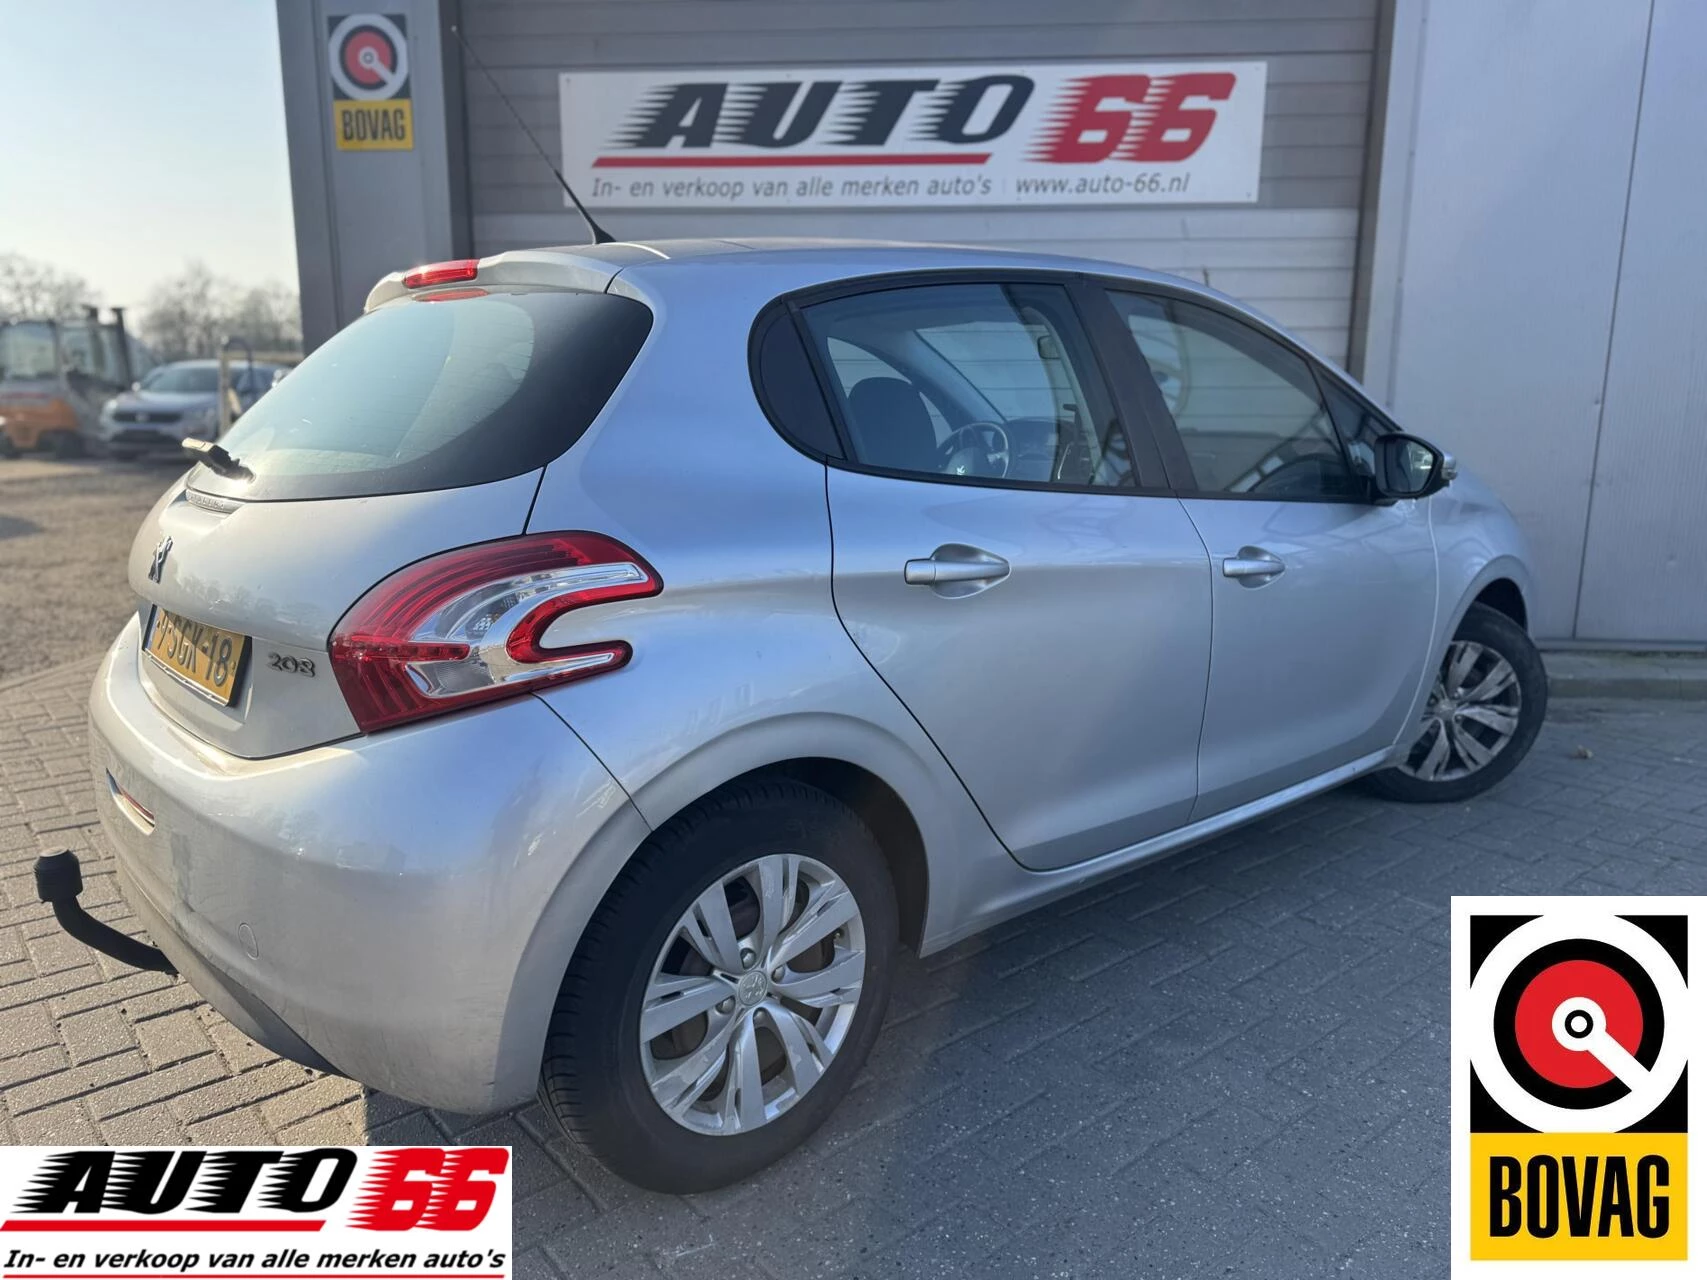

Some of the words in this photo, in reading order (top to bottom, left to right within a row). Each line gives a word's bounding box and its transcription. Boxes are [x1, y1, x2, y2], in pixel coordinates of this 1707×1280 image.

[341, 108, 406, 142] BOVAG
[601, 75, 1035, 148] AUTO
[1020, 73, 1237, 163] 66
[592, 177, 621, 198] In-
[629, 182, 655, 197] en
[663, 177, 744, 201] verkoop
[752, 181, 788, 197] van
[796, 176, 833, 197] alle
[841, 175, 919, 196] merken
[927, 174, 992, 196] auto's
[1016, 172, 1191, 194] www.auto-66.nl
[268, 652, 316, 678] 208
